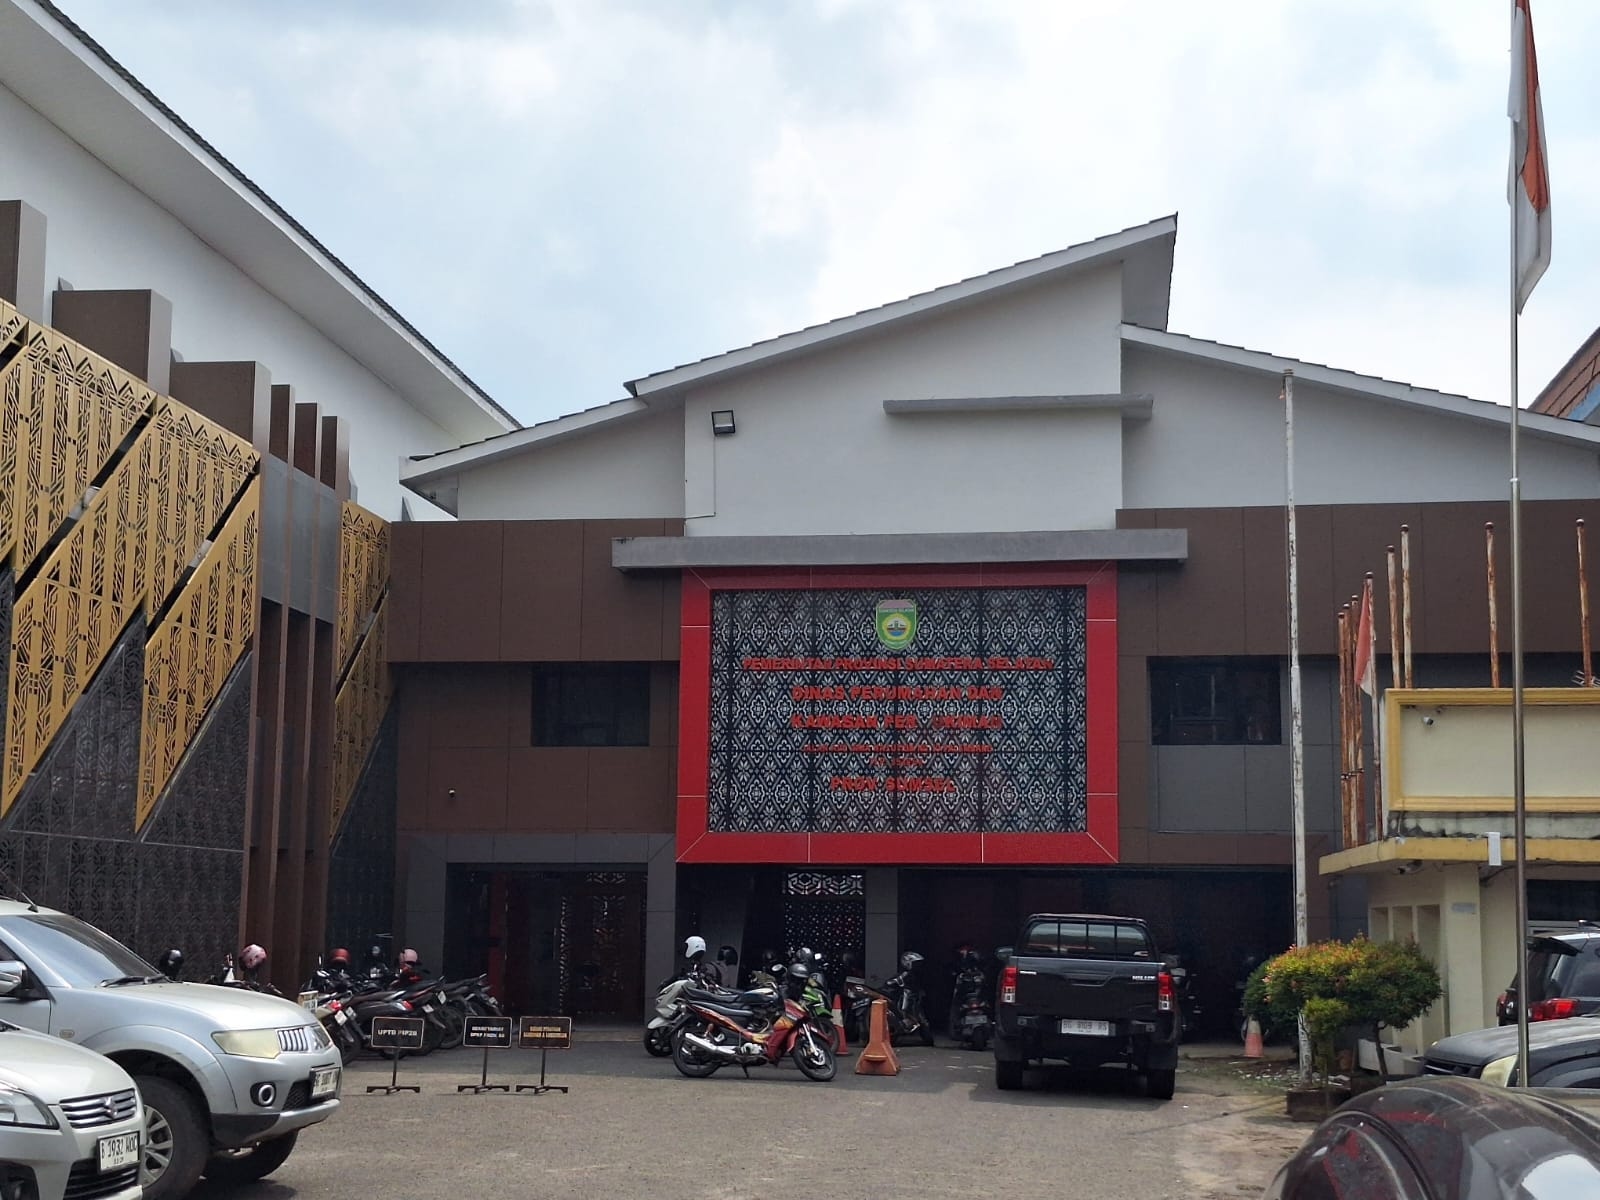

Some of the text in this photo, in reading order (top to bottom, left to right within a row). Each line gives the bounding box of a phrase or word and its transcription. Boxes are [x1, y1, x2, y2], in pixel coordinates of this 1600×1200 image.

[742, 657, 1054, 671] PEMERINTAH PROVINSI SUMATERA SELATAN
[792, 686, 1004, 701] DINAS PERUMAHAN DAN
[791, 714, 879, 730] KAWASAN
[885, 776, 957, 793] SUMSEL
